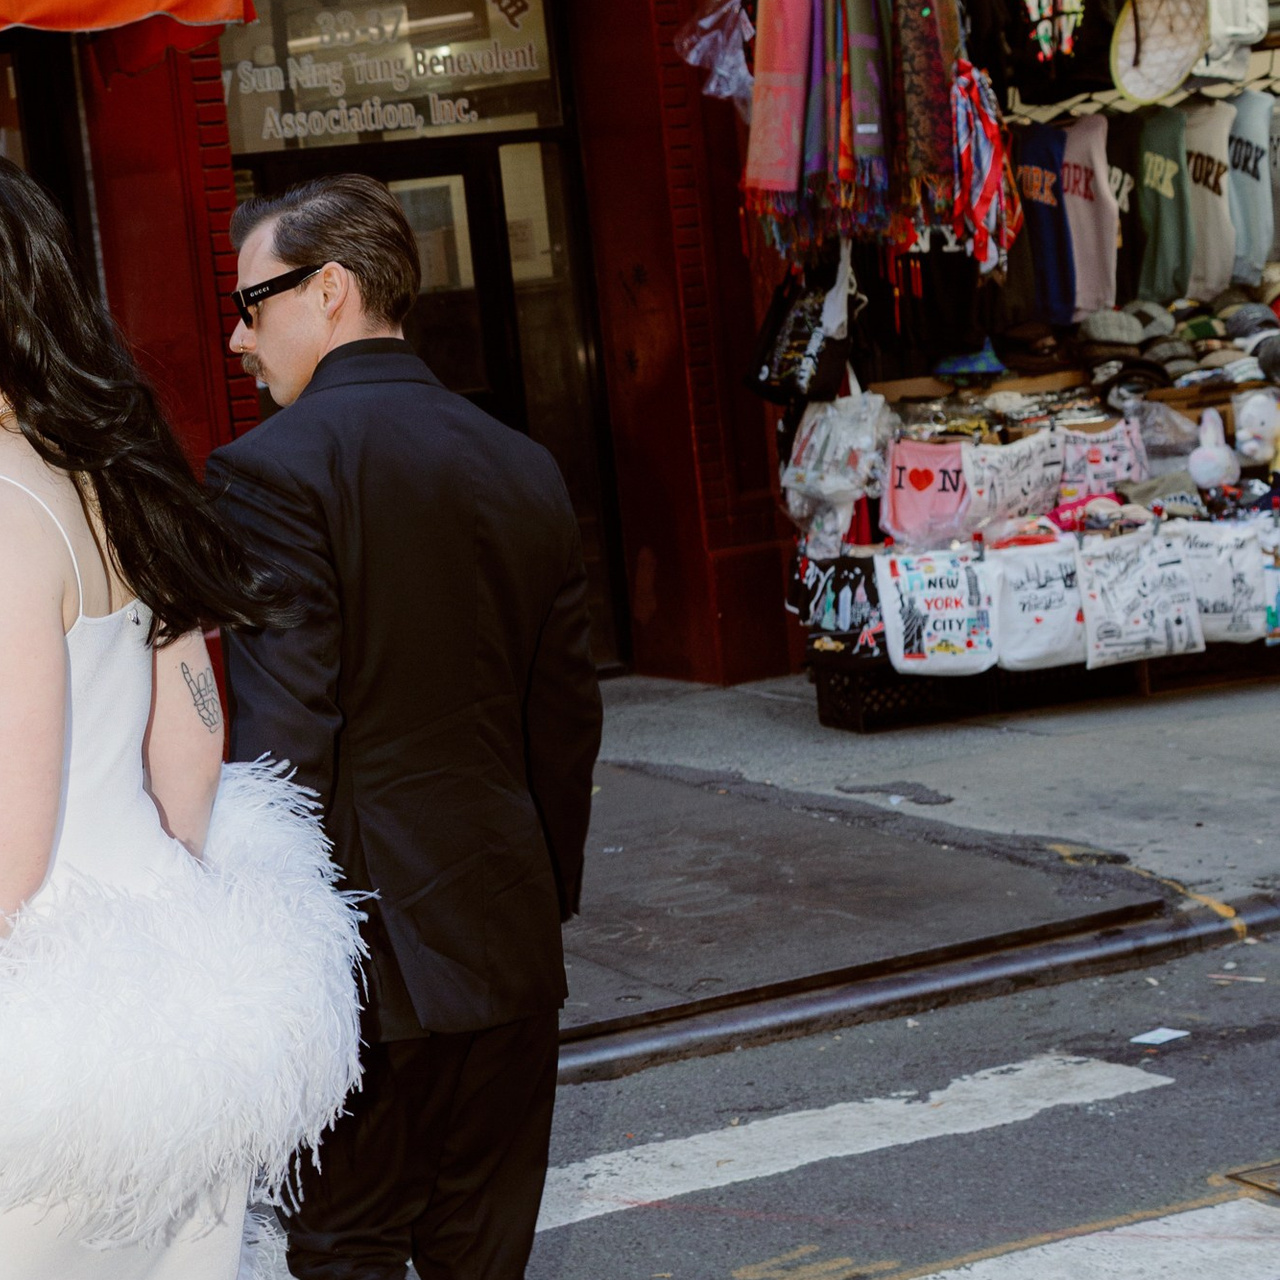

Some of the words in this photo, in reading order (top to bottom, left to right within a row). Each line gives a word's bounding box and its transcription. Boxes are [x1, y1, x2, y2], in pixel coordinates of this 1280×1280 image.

[316, 7, 403, 49] 33-37
[238, 61, 285, 94] Sun
[414, 41, 539, 78] Benevolent
[262, 97, 424, 139] Association,
[430, 93, 478, 124] Inc.
[249, 286, 270, 298] GUCCI
[894, 465, 907, 490] I
[937, 468, 963, 493] N
[926, 576, 960, 592] NEW
[924, 595, 965, 612] YORK
[931, 617, 966, 632] CITY
